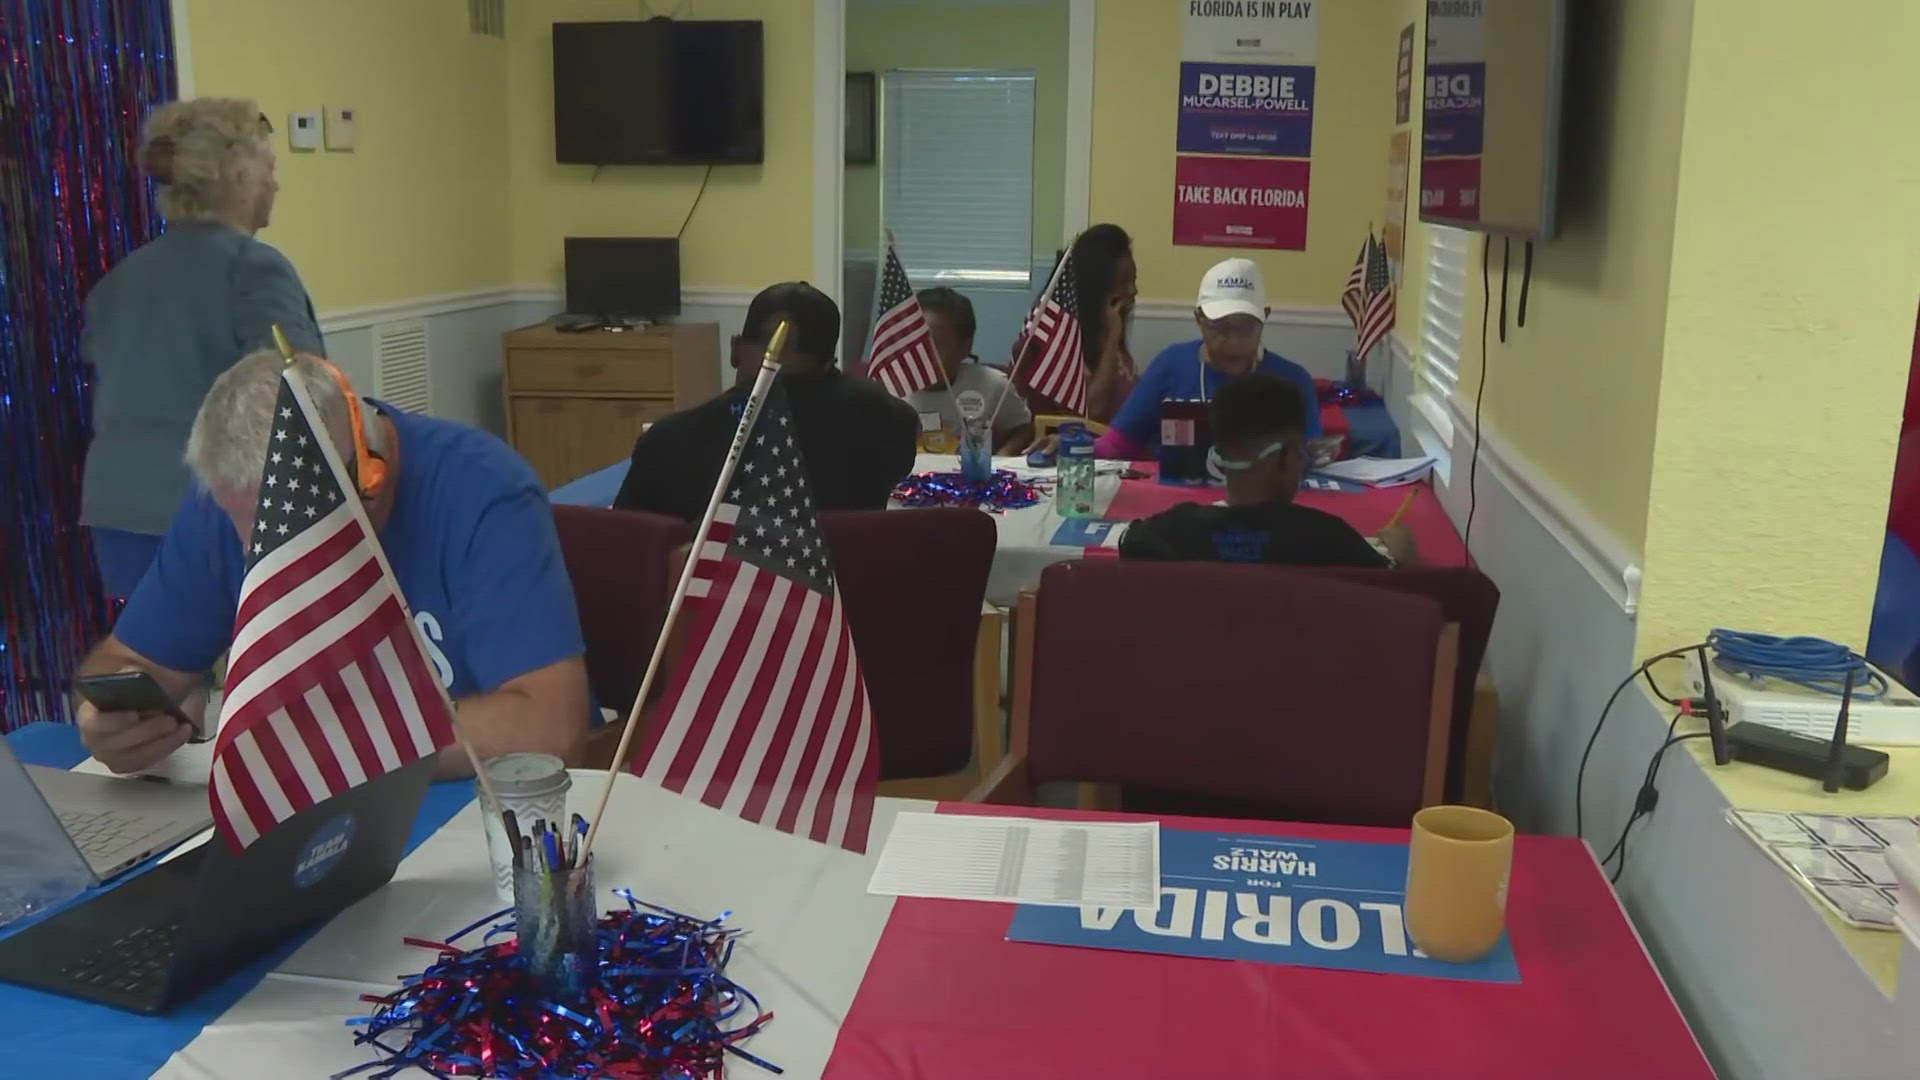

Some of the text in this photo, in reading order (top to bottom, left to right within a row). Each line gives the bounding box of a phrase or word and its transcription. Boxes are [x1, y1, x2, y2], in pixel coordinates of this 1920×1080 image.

[1190, 0, 1311, 19] FLORIDA IS IN PLAY
[1198, 73, 1296, 99] DEBBIE
[1183, 95, 1310, 111] MUCARSEL-POWELL
[1178, 185, 1305, 208] TAKE BACK FLORIDA
[1230, 847, 1299, 860] WALZ
[1213, 855, 1316, 877] HARRIS
[1246, 879, 1282, 888] FOR
[1079, 887, 1428, 958] LORIDA
